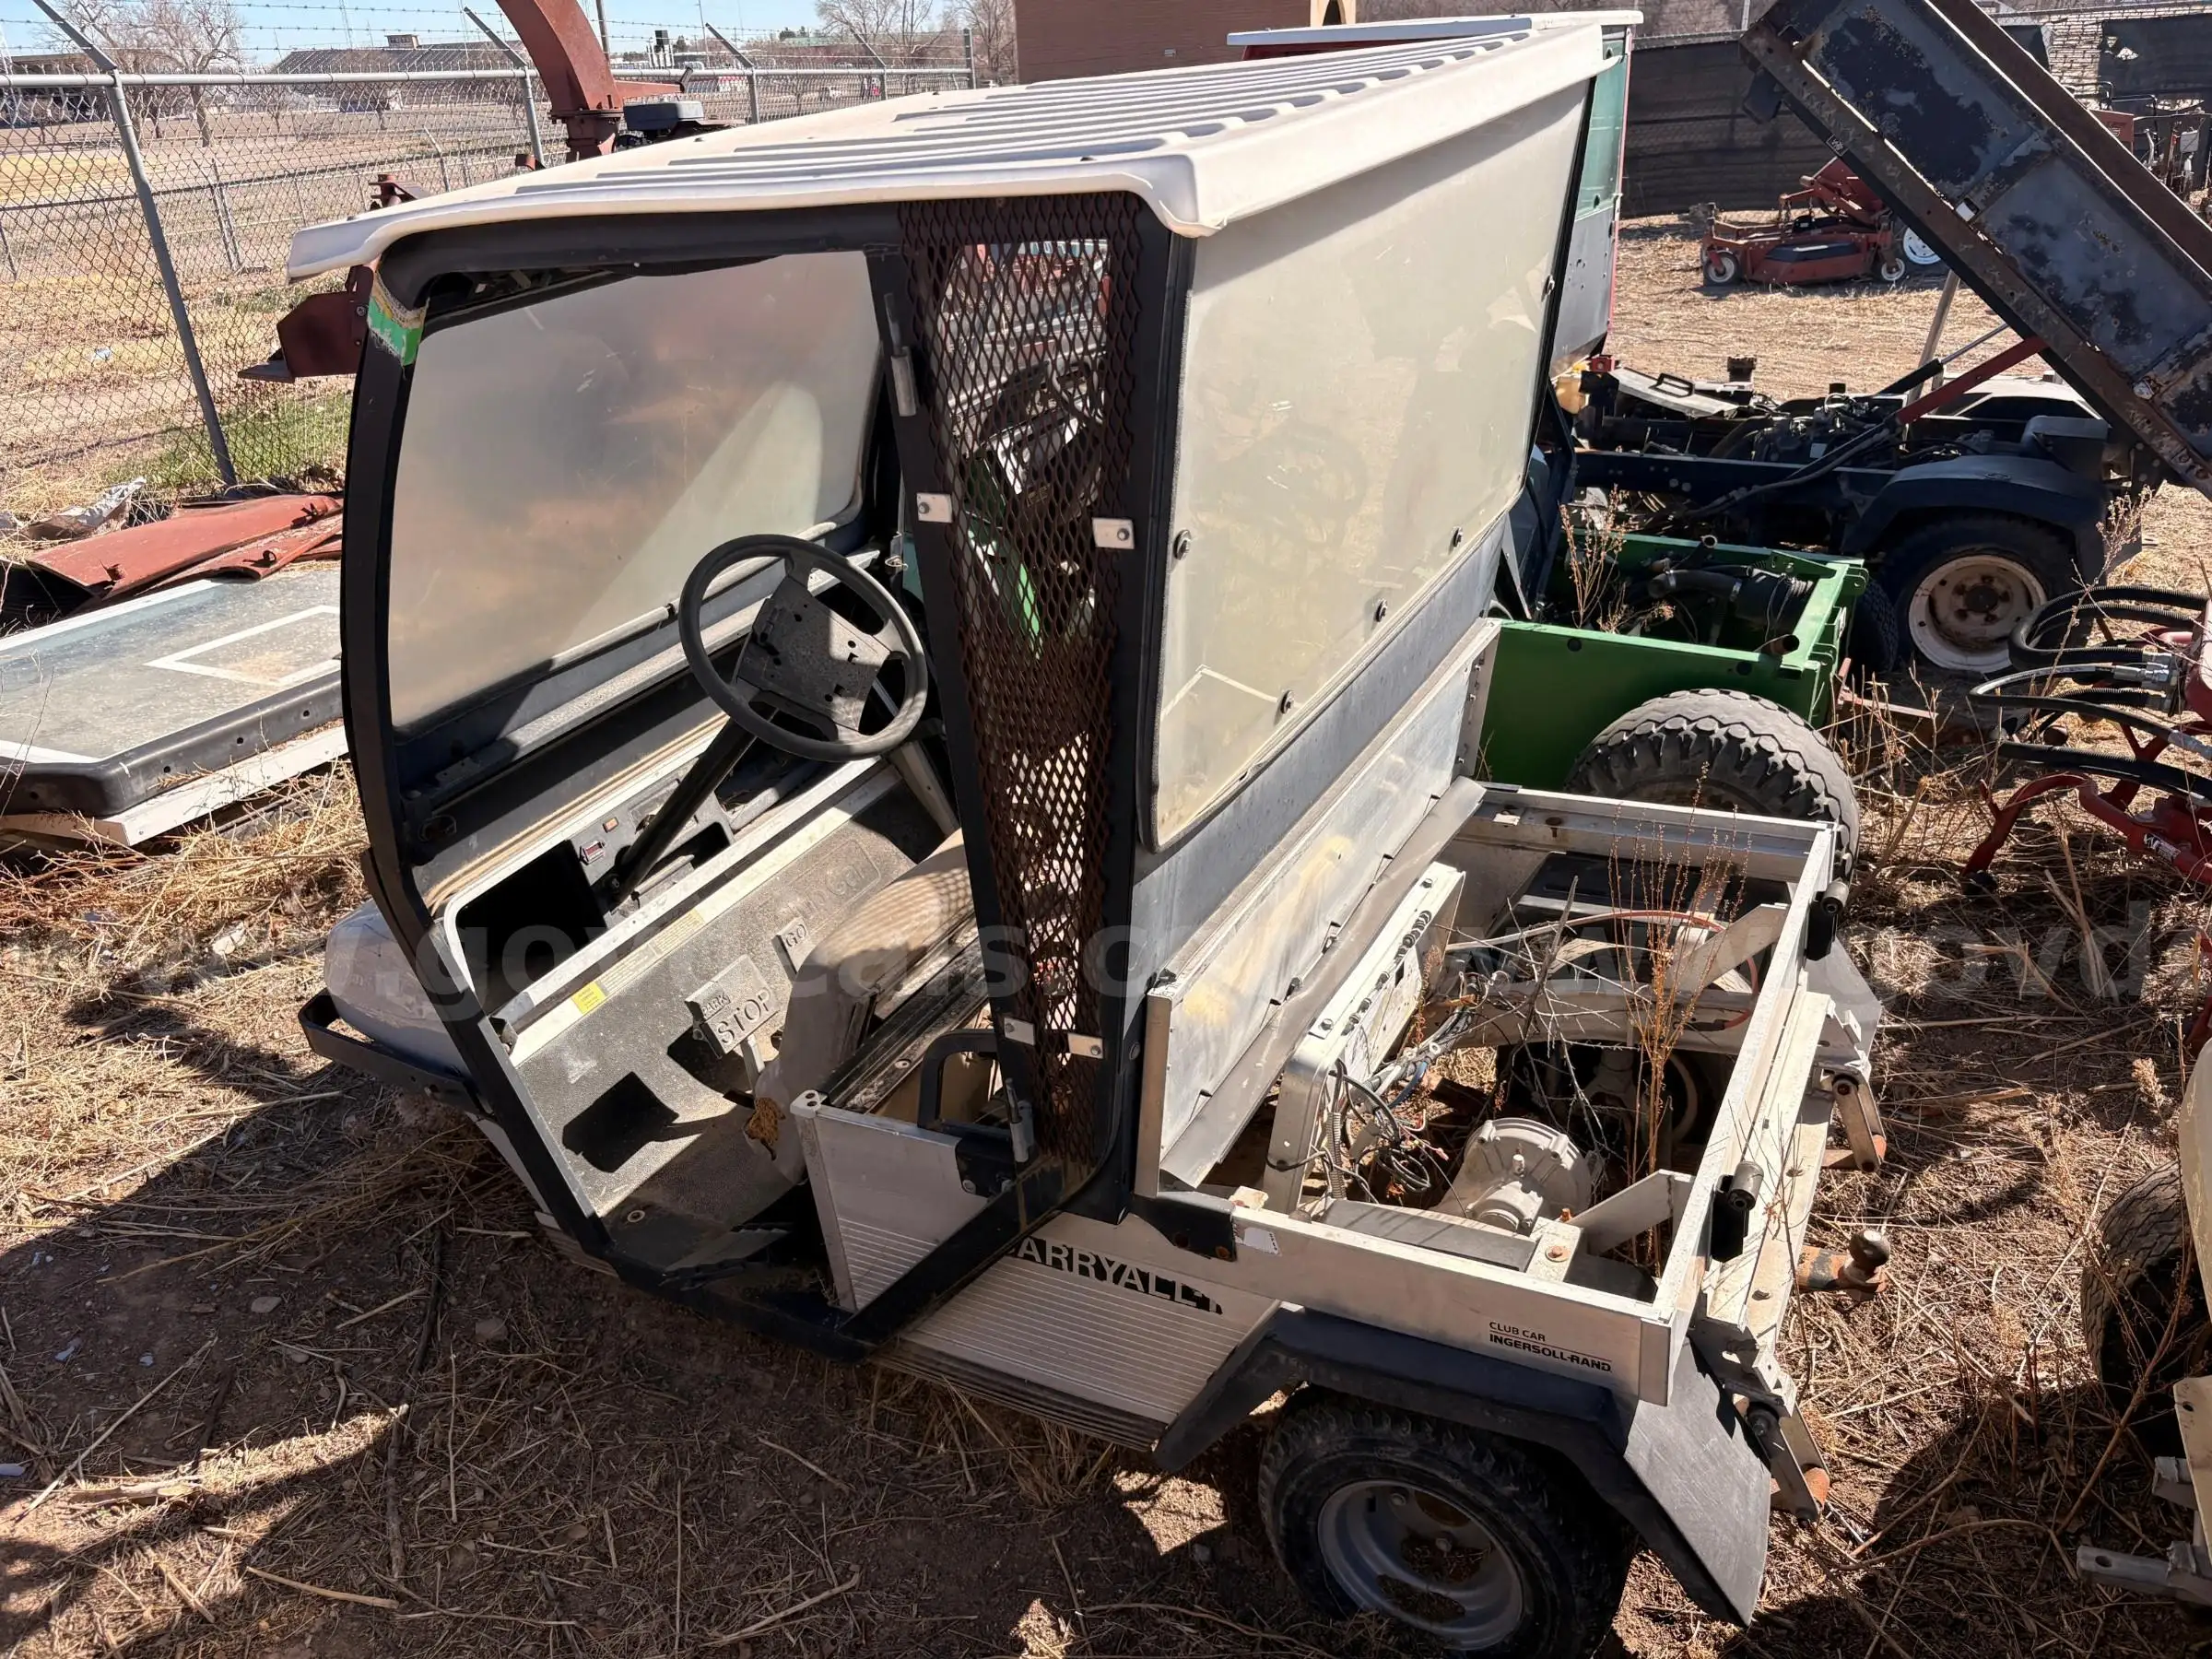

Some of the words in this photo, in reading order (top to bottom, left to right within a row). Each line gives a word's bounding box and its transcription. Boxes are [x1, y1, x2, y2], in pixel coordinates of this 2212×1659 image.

[785, 924, 808, 948] GO
[701, 992, 732, 1018] PARK
[717, 986, 771, 1045] STOP
[1006, 1235, 1198, 1308] ARRYALL
[1488, 1321, 1520, 1335] CLUB
[1522, 1330, 1547, 1342] CAR
[1488, 1333, 1612, 1372] INGERSOLL-RAND
